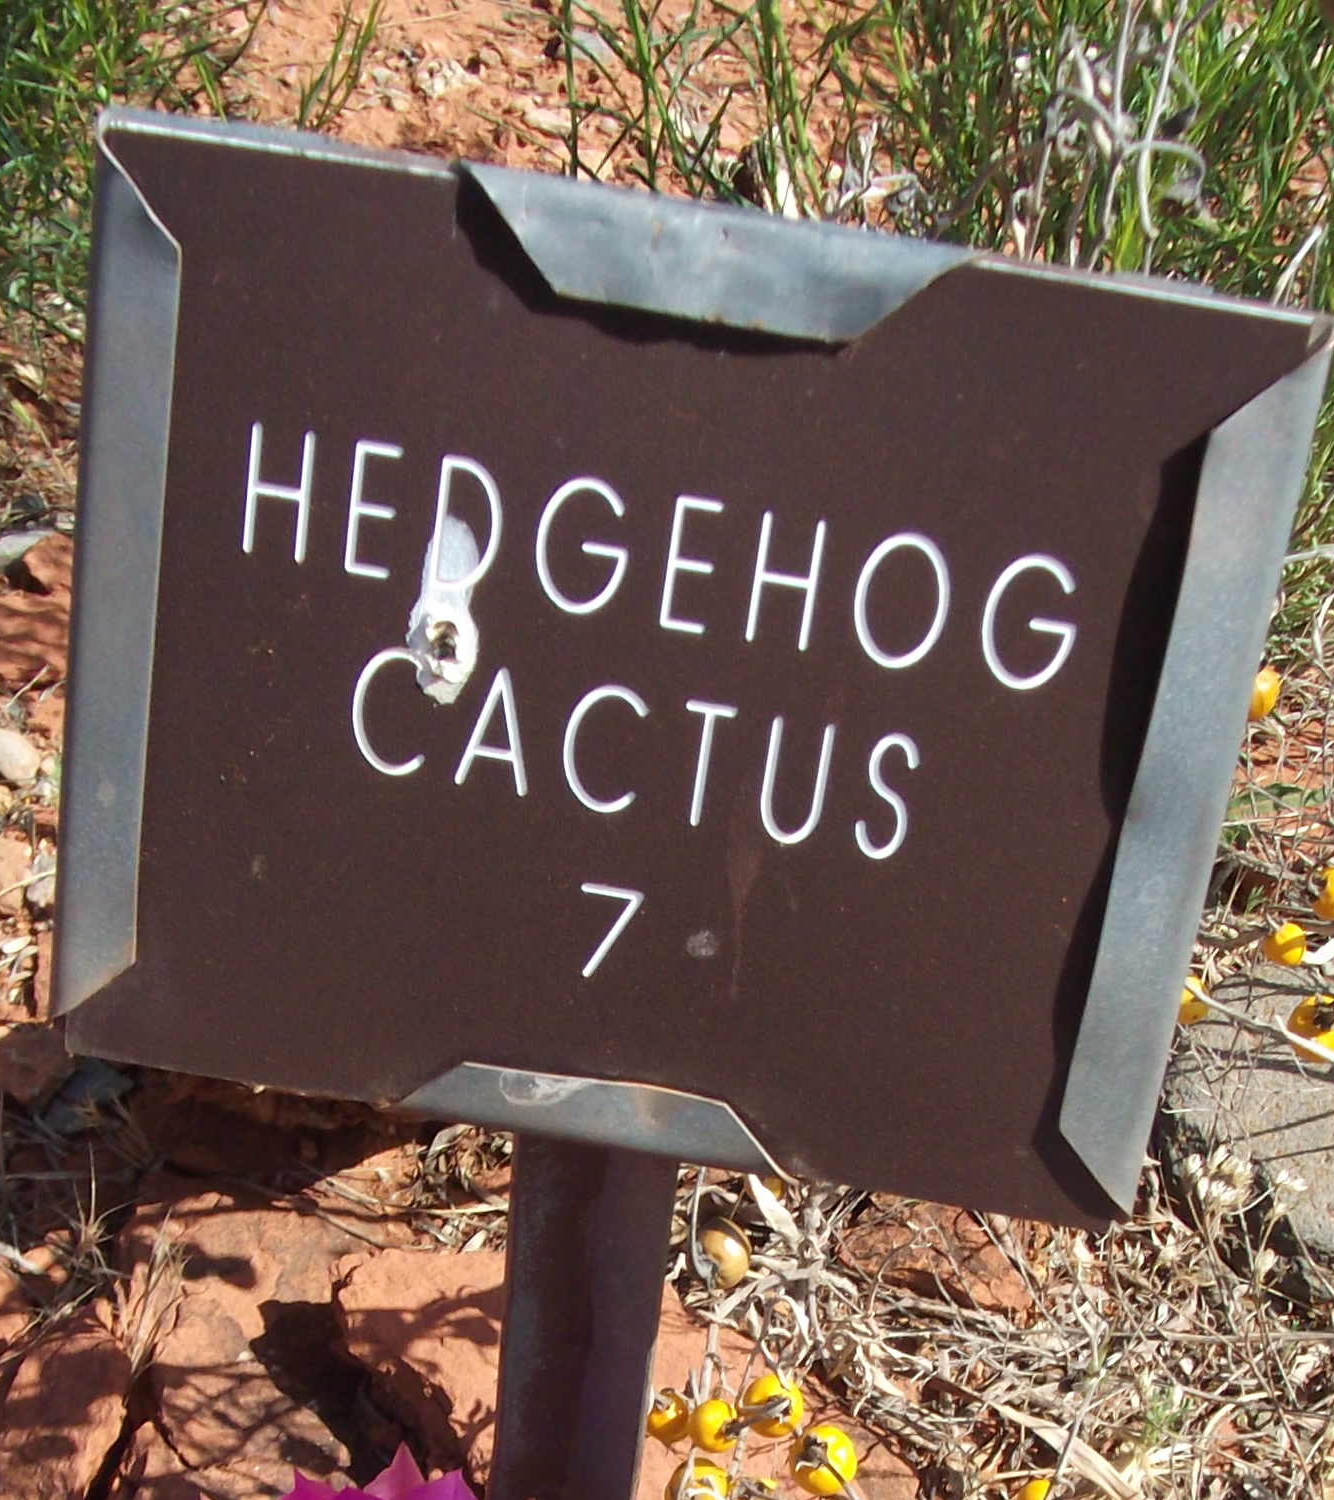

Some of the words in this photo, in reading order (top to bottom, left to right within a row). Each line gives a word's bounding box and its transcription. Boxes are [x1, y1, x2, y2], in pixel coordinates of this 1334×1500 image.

[241, 421, 1078, 692] HEDGEHOG
[351, 646, 922, 861] CACTUS
[579, 881, 645, 979] 7
